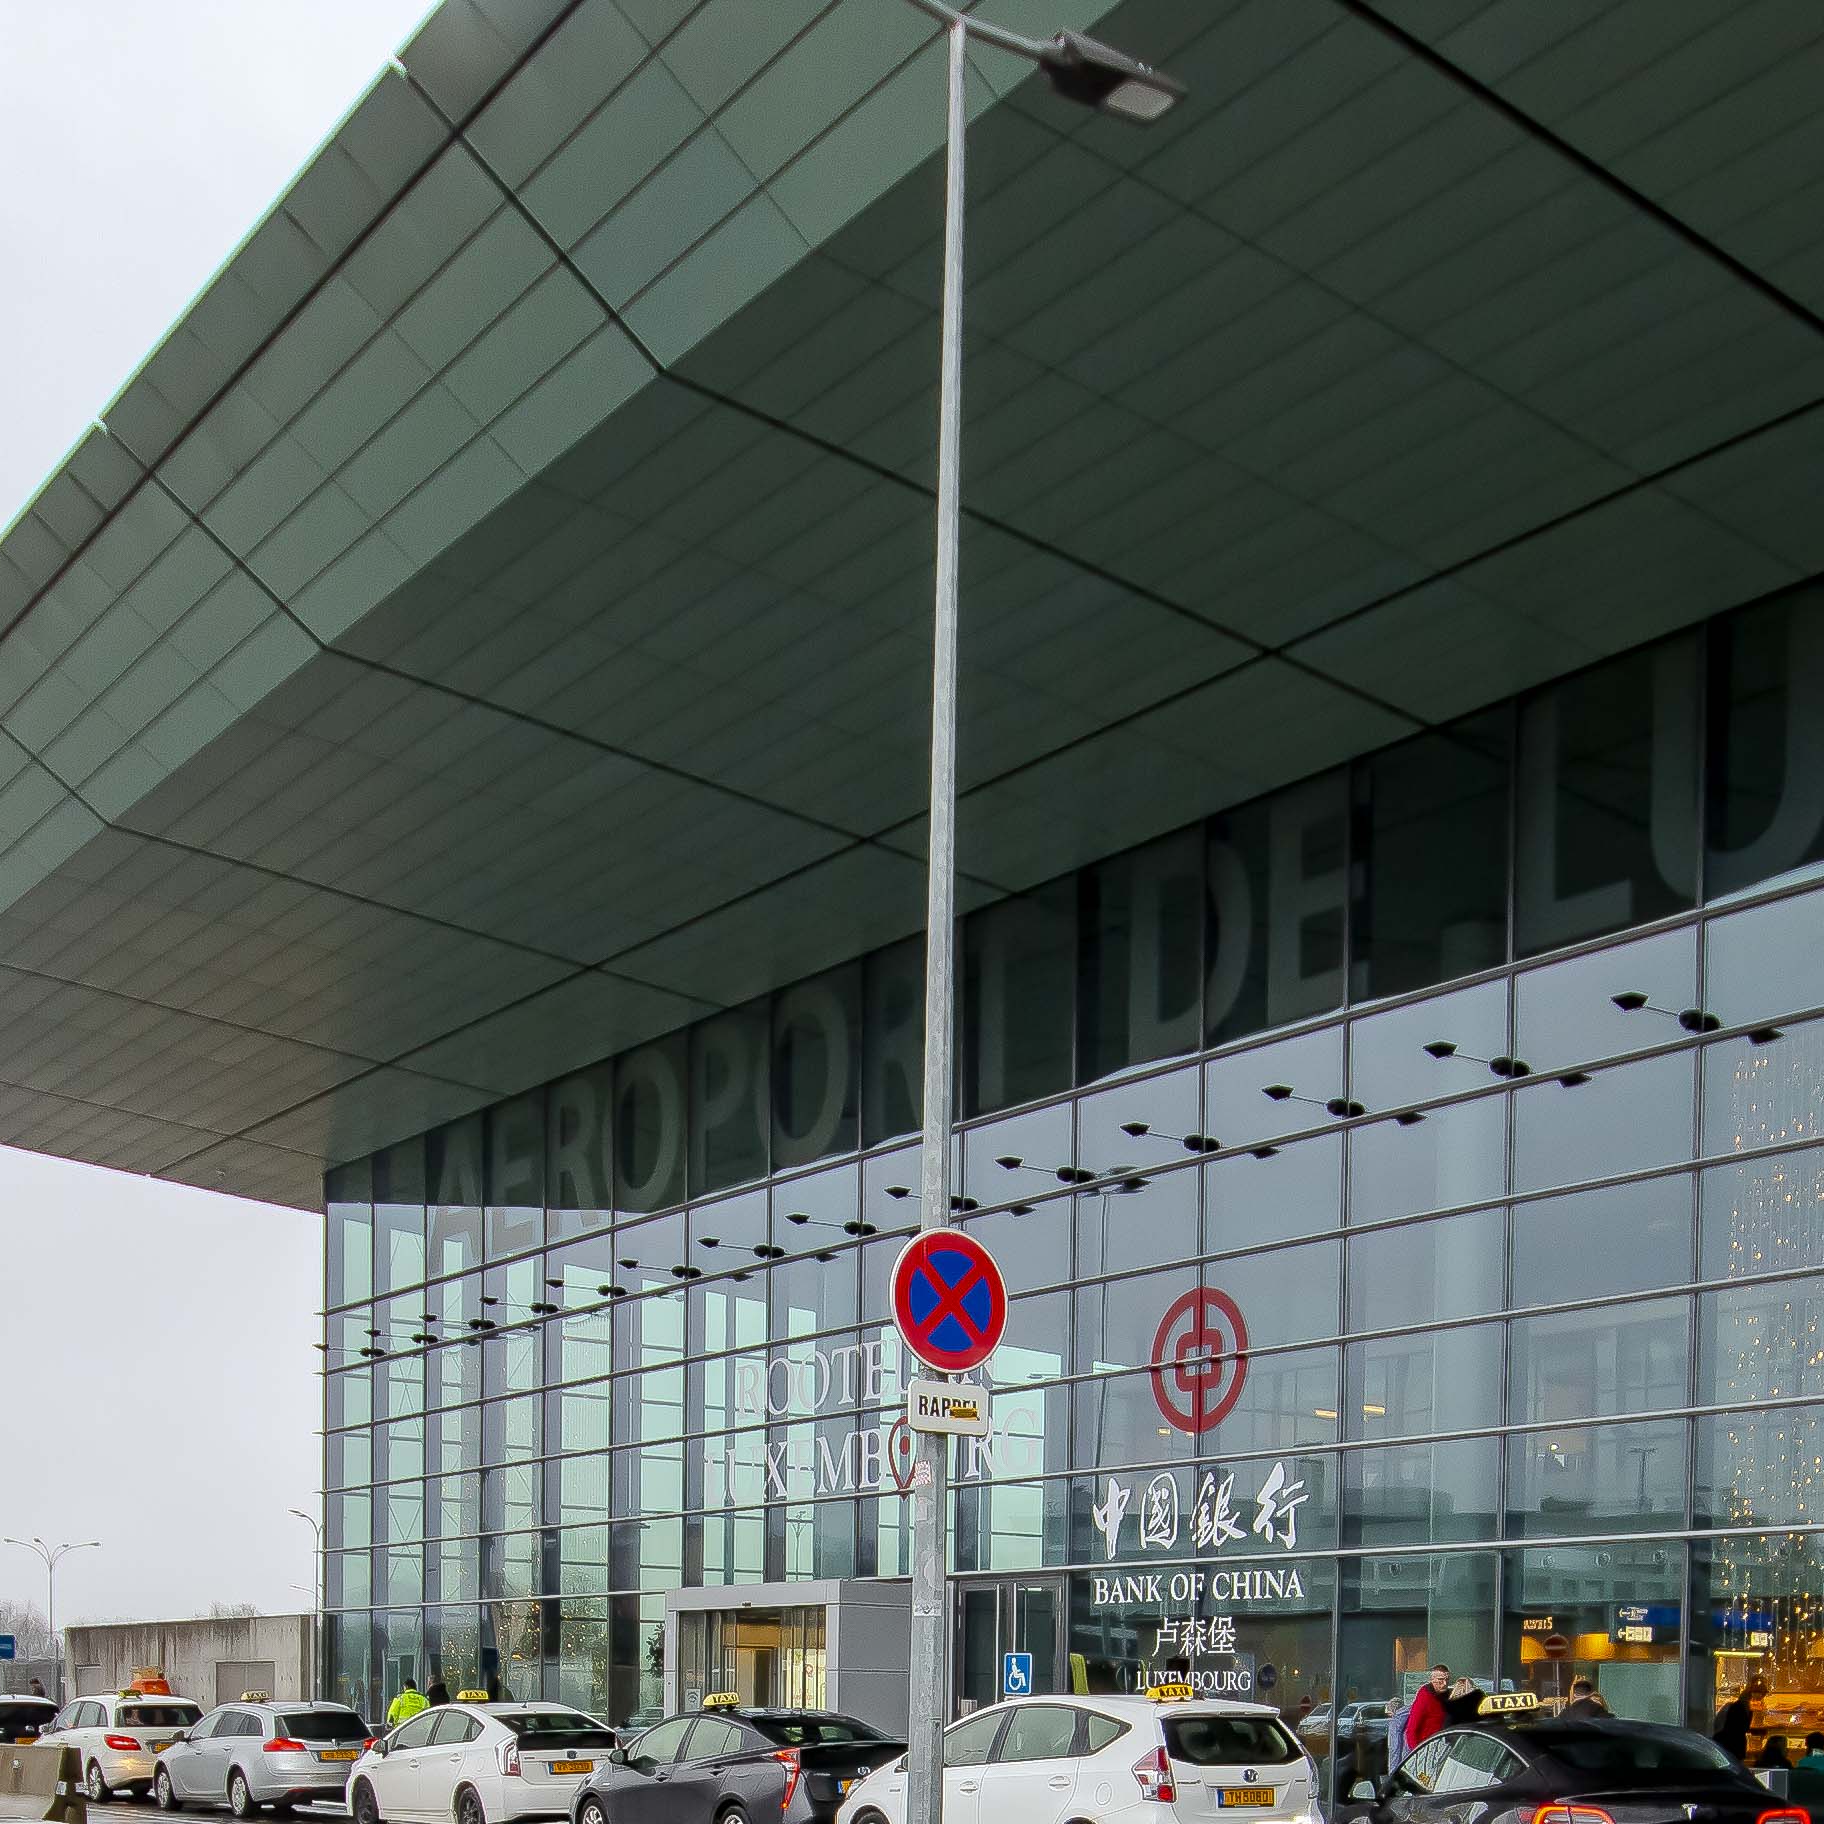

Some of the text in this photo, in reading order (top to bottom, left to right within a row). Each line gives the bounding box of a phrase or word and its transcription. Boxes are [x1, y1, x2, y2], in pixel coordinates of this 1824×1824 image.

[428, 900, 1071, 1275] AEROPORT
[1128, 785, 1372, 1065] DE
[1094, 1568, 1304, 1605] BANK OF CHINA
[1152, 1616, 1237, 1656] 卢森堡
[1136, 1670, 1251, 1691] LUXEMBOURG
[712, 1694, 738, 1703] TAXI
[1160, 1687, 1190, 1698] TAXI
[1493, 1695, 1532, 1709] TAXI
